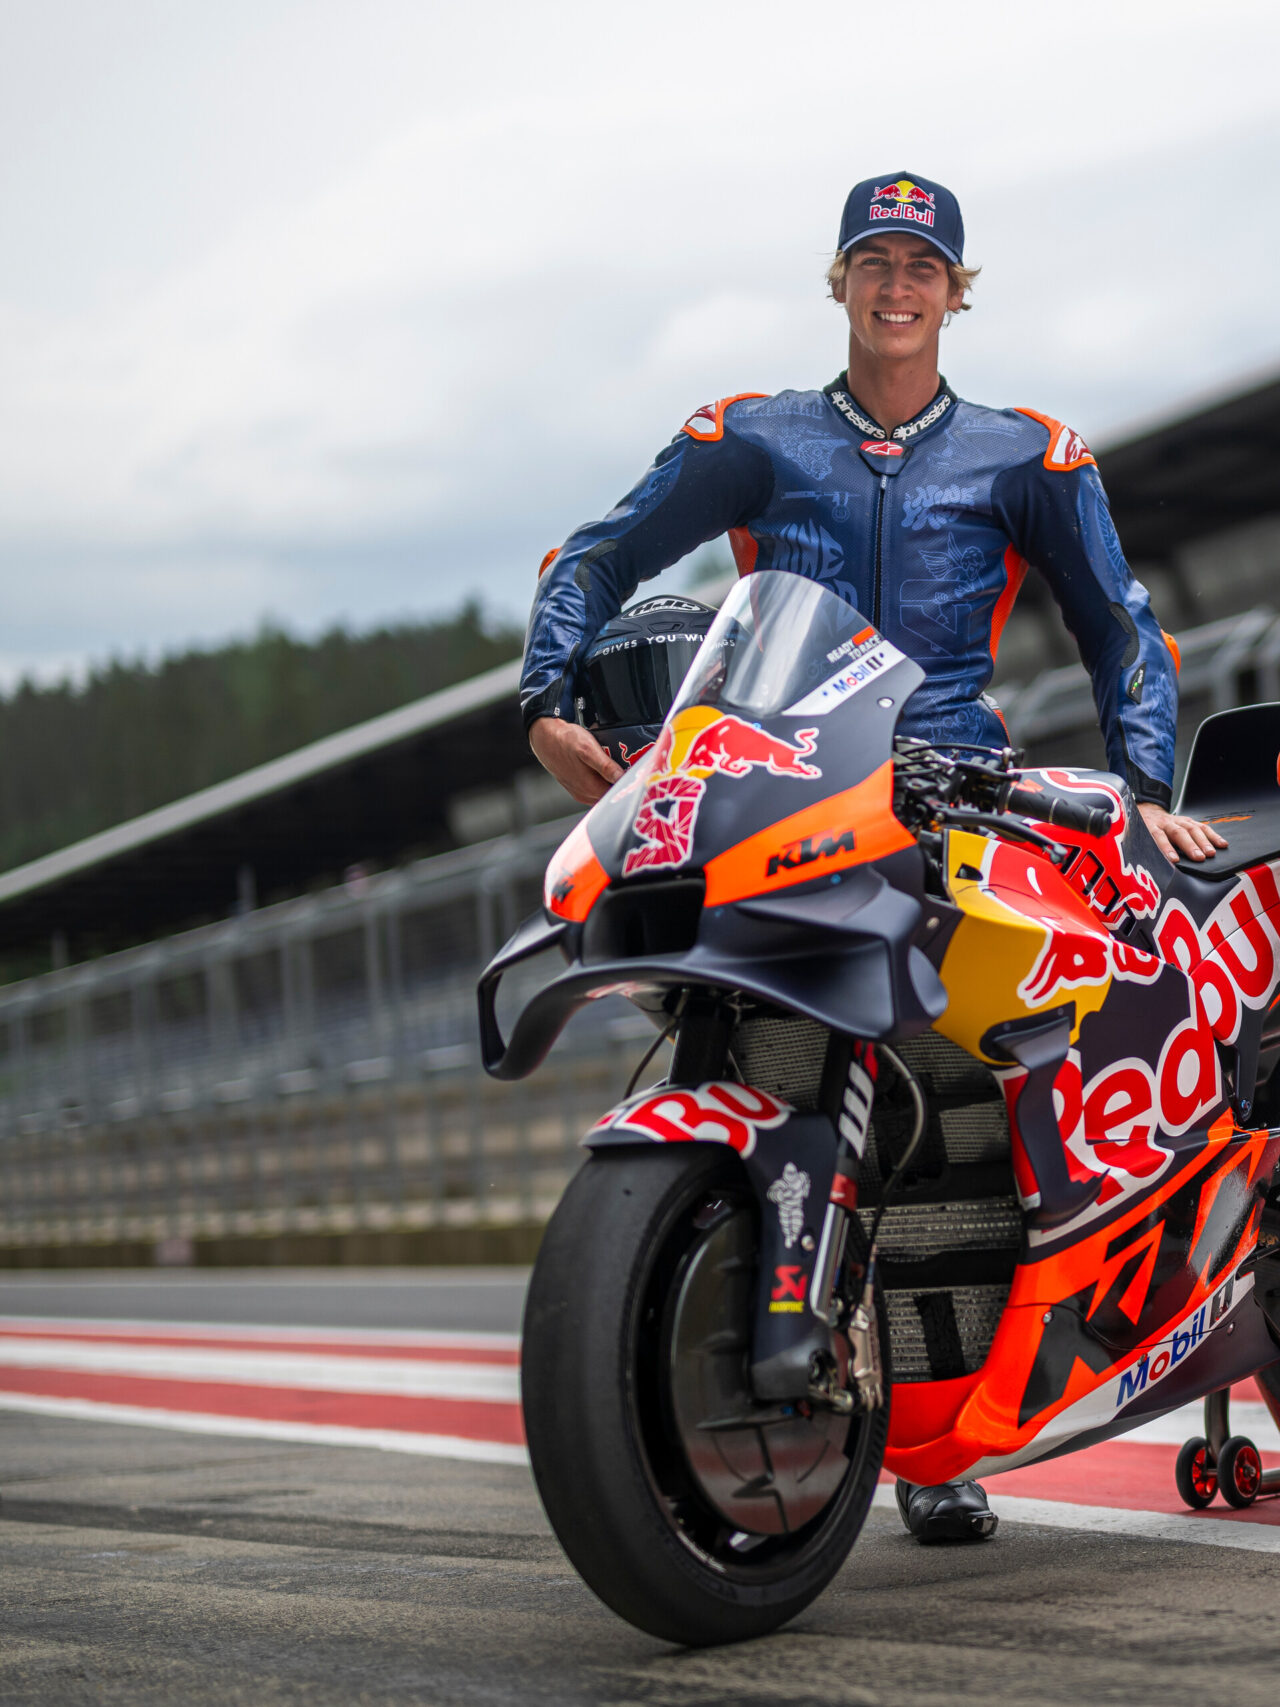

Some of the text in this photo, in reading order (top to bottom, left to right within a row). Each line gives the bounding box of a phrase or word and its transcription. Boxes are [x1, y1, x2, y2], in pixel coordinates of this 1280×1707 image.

[869, 203, 935, 227] Red Bull
[831, 391, 886, 439] alpinestars
[892, 394, 951, 441] alpinestars
[628, 599, 702, 617] HJC
[602, 639, 638, 656] GIVES
[646, 633, 676, 645] YOU
[826, 639, 855, 664] READY
[848, 635, 882, 661] TO RACE
[832, 664, 873, 695] Mobil
[766, 829, 857, 877] KTM
[993, 975, 1222, 1236] Red
[1116, 1305, 1208, 1407] Mobil
